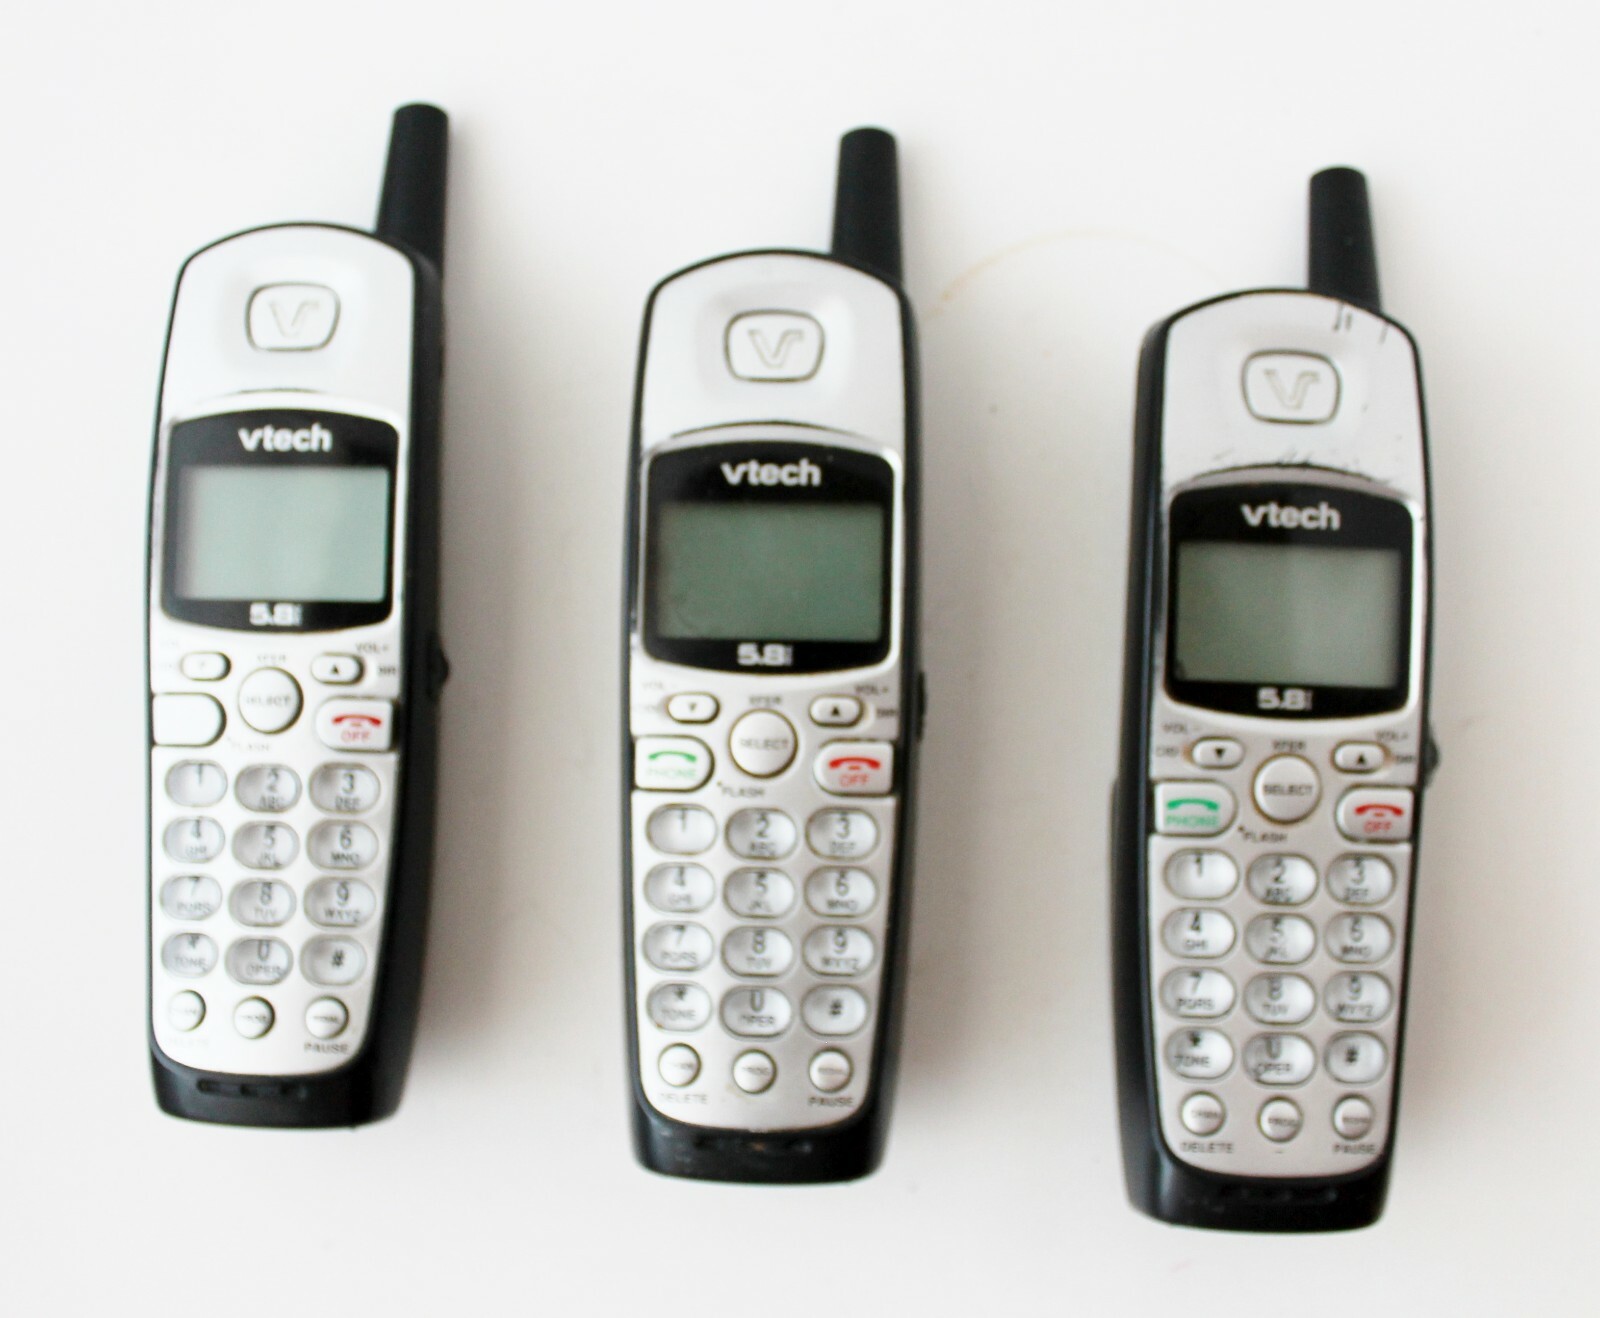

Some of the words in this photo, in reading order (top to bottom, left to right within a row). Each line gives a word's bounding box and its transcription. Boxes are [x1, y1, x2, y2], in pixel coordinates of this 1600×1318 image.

[238, 422, 333, 452] vtech
[721, 458, 821, 487] vtech
[1241, 501, 1341, 530] vtech
[341, 730, 371, 743] OFF
[267, 768, 280, 792] 2
[341, 773, 355, 794] 3
[839, 774, 868, 787] OFF
[1264, 784, 1313, 795] SELECT
[756, 814, 770, 838] 2
[836, 813, 849, 839] 3
[1166, 815, 1220, 827] PHONE
[1363, 821, 1392, 834] OFF
[264, 825, 276, 848] 5
[339, 825, 352, 849] 6
[1273, 858, 1286, 883] 2
[1352, 857, 1365, 882] 3
[261, 882, 273, 906] 8
[337, 881, 350, 906] 9
[755, 869, 768, 895] 5
[835, 872, 849, 896] 6
[1191, 912, 1203, 933] 4
[674, 924, 687, 946] 7
[753, 929, 766, 954] 8
[833, 929, 847, 954] 9
[331, 950, 344, 967] #
[1191, 970, 1203, 993] 7
[303, 1043, 349, 1053] PAUSE
